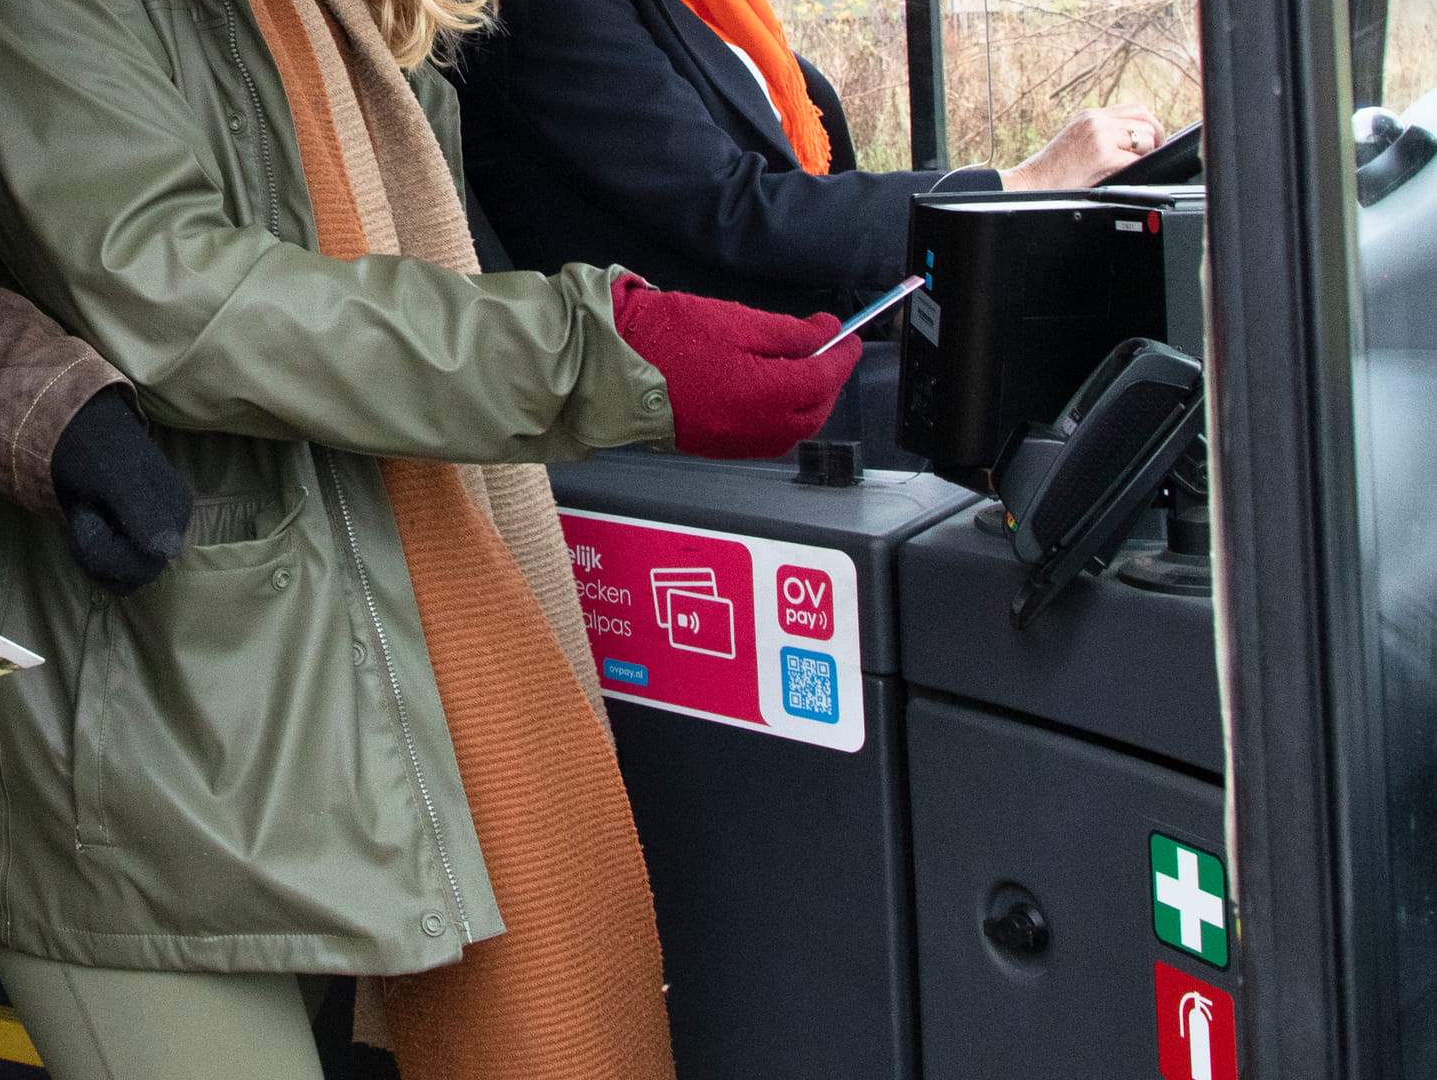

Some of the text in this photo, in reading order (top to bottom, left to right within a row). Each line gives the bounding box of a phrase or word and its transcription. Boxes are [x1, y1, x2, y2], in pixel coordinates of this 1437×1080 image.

[783, 576, 826, 609] OV
[786, 608, 817, 630] pay
[609, 665, 643, 679] ovpay.nl
